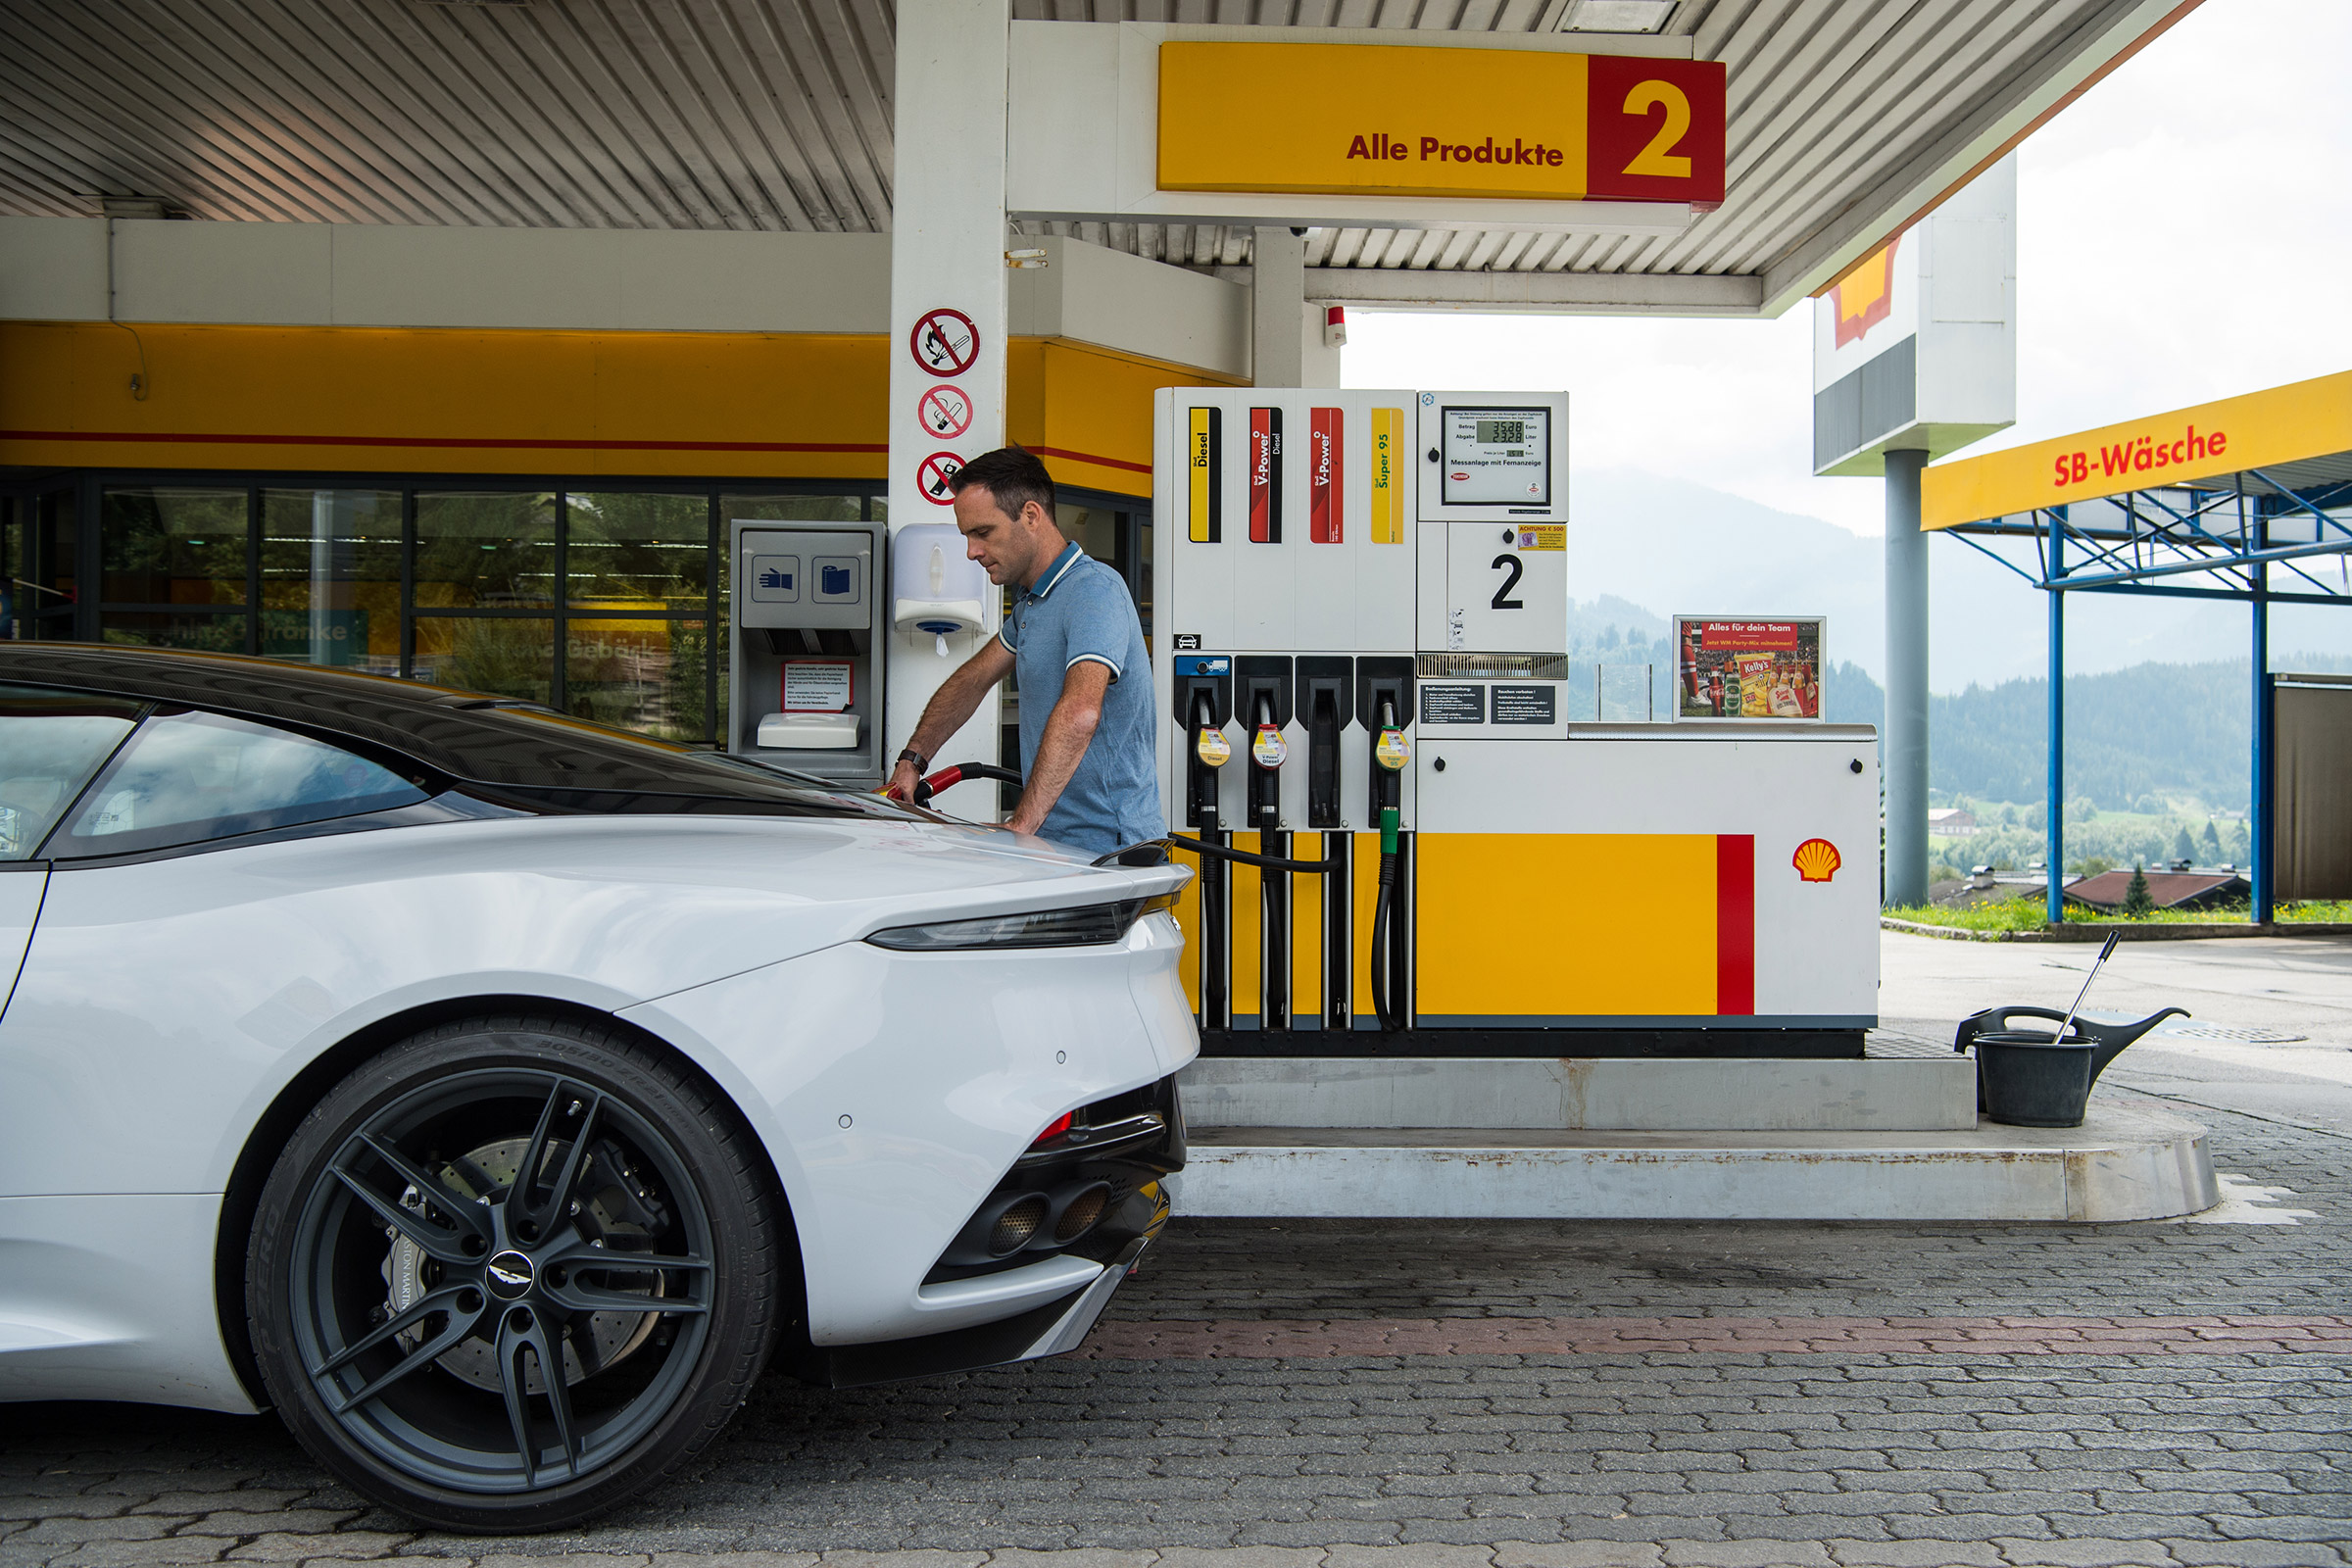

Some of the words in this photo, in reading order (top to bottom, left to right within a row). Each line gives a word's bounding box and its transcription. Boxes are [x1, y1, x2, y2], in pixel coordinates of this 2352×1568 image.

[1620, 78, 1692, 178] 2
[1347, 133, 1408, 161] Alle
[1419, 136, 1564, 168] Produkte
[1197, 433, 1208, 467] Diesel
[1258, 433, 1269, 486] V-Power
[1272, 433, 1280, 455] Diesel
[1379, 434, 1388, 450] 95
[2053, 423, 2228, 488] SB-Wäsche
[1319, 434, 1330, 486] V-Power
[1379, 453, 1390, 488] Super
[1490, 554, 1524, 611] 2
[1732, 623, 1745, 631] für
[1744, 661, 1769, 674] Kelly's
[401, 1272, 411, 1310] MARTIN
